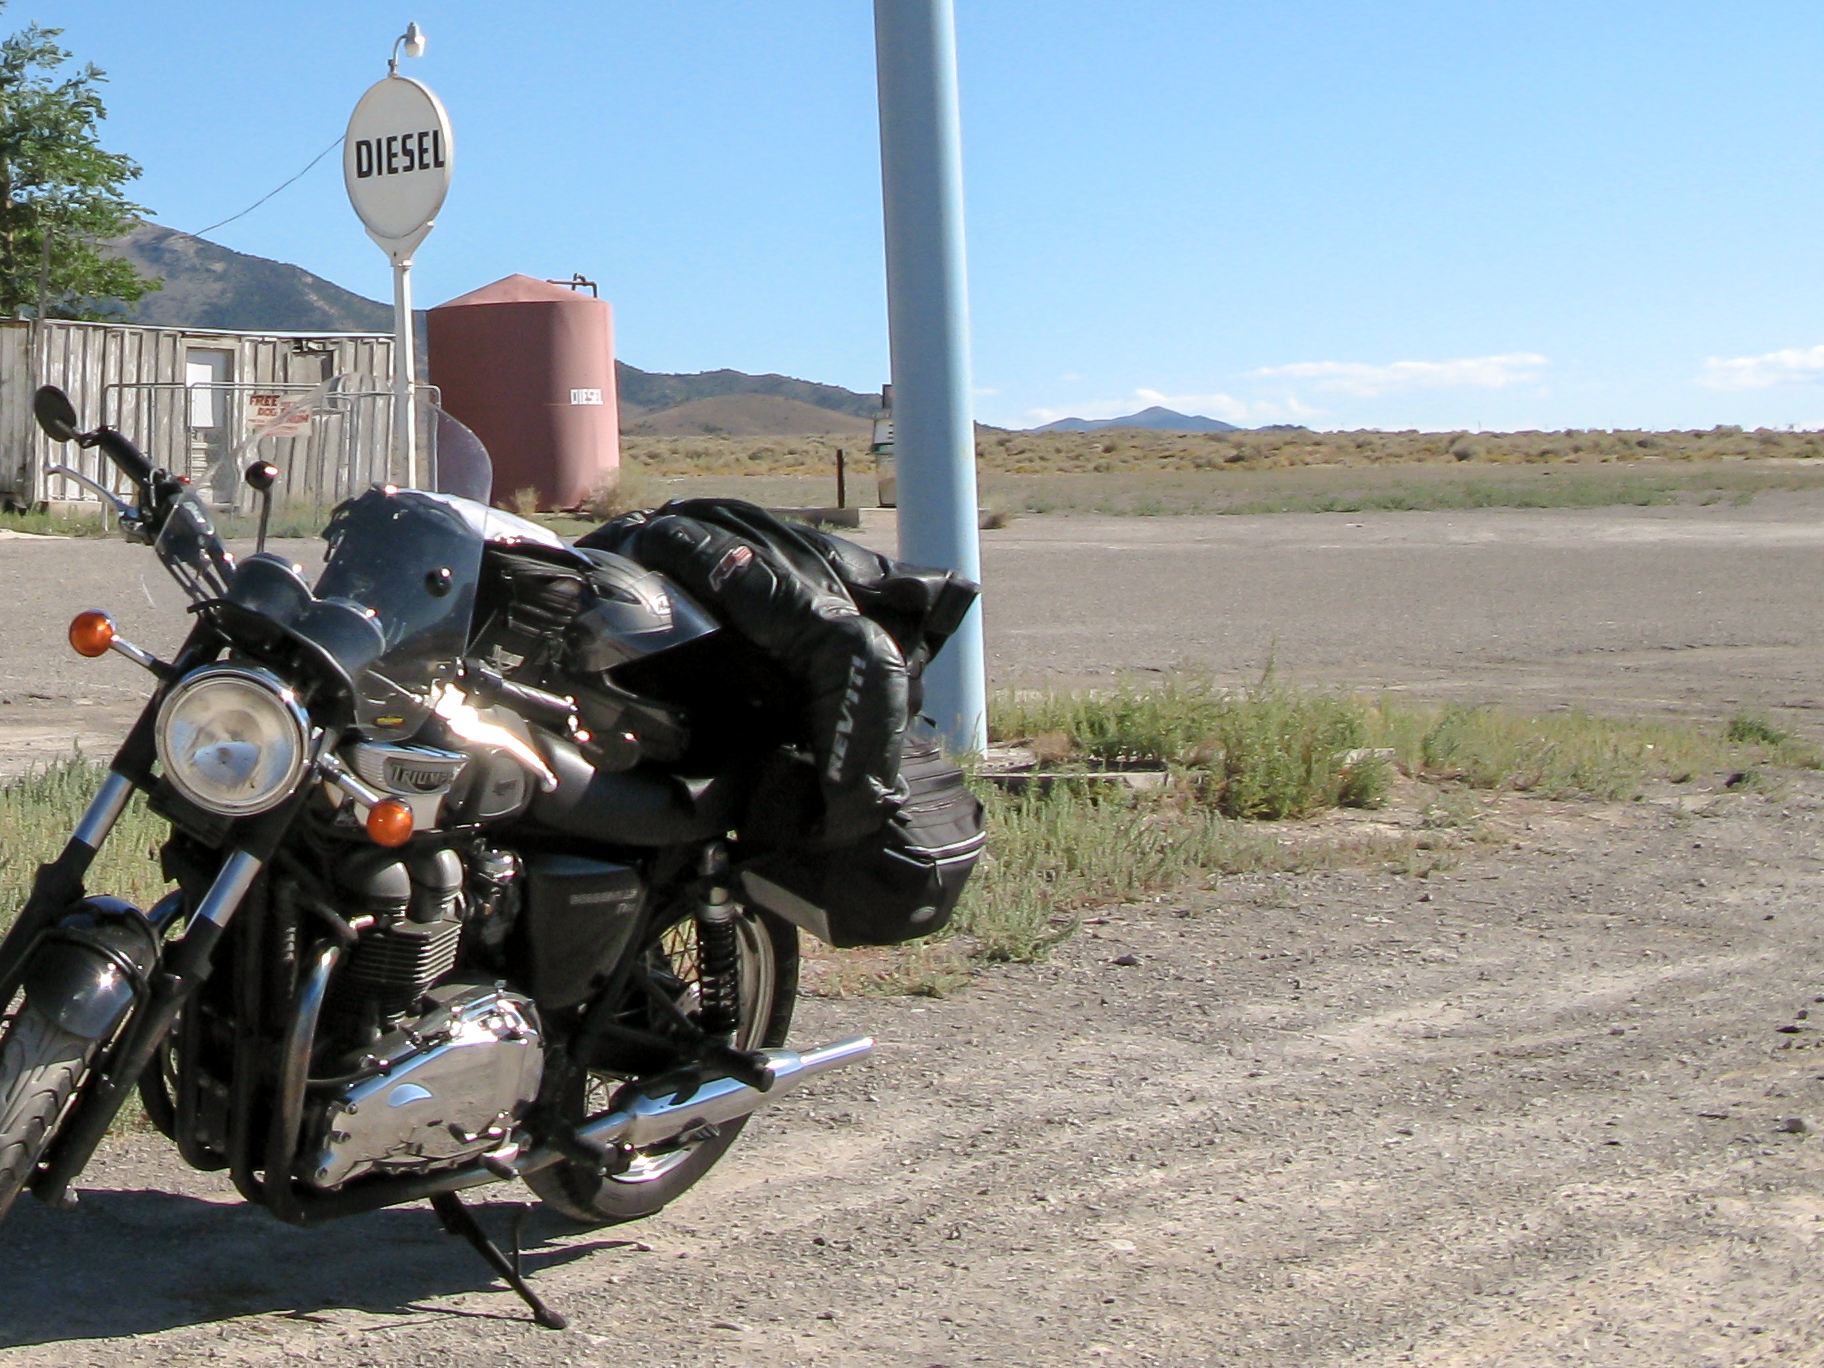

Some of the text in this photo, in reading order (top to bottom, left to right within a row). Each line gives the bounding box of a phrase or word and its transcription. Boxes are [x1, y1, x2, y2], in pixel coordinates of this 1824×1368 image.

[355, 129, 445, 179] DIESEL
[250, 395, 280, 406] FREE
[570, 388, 604, 405] DIESEL
